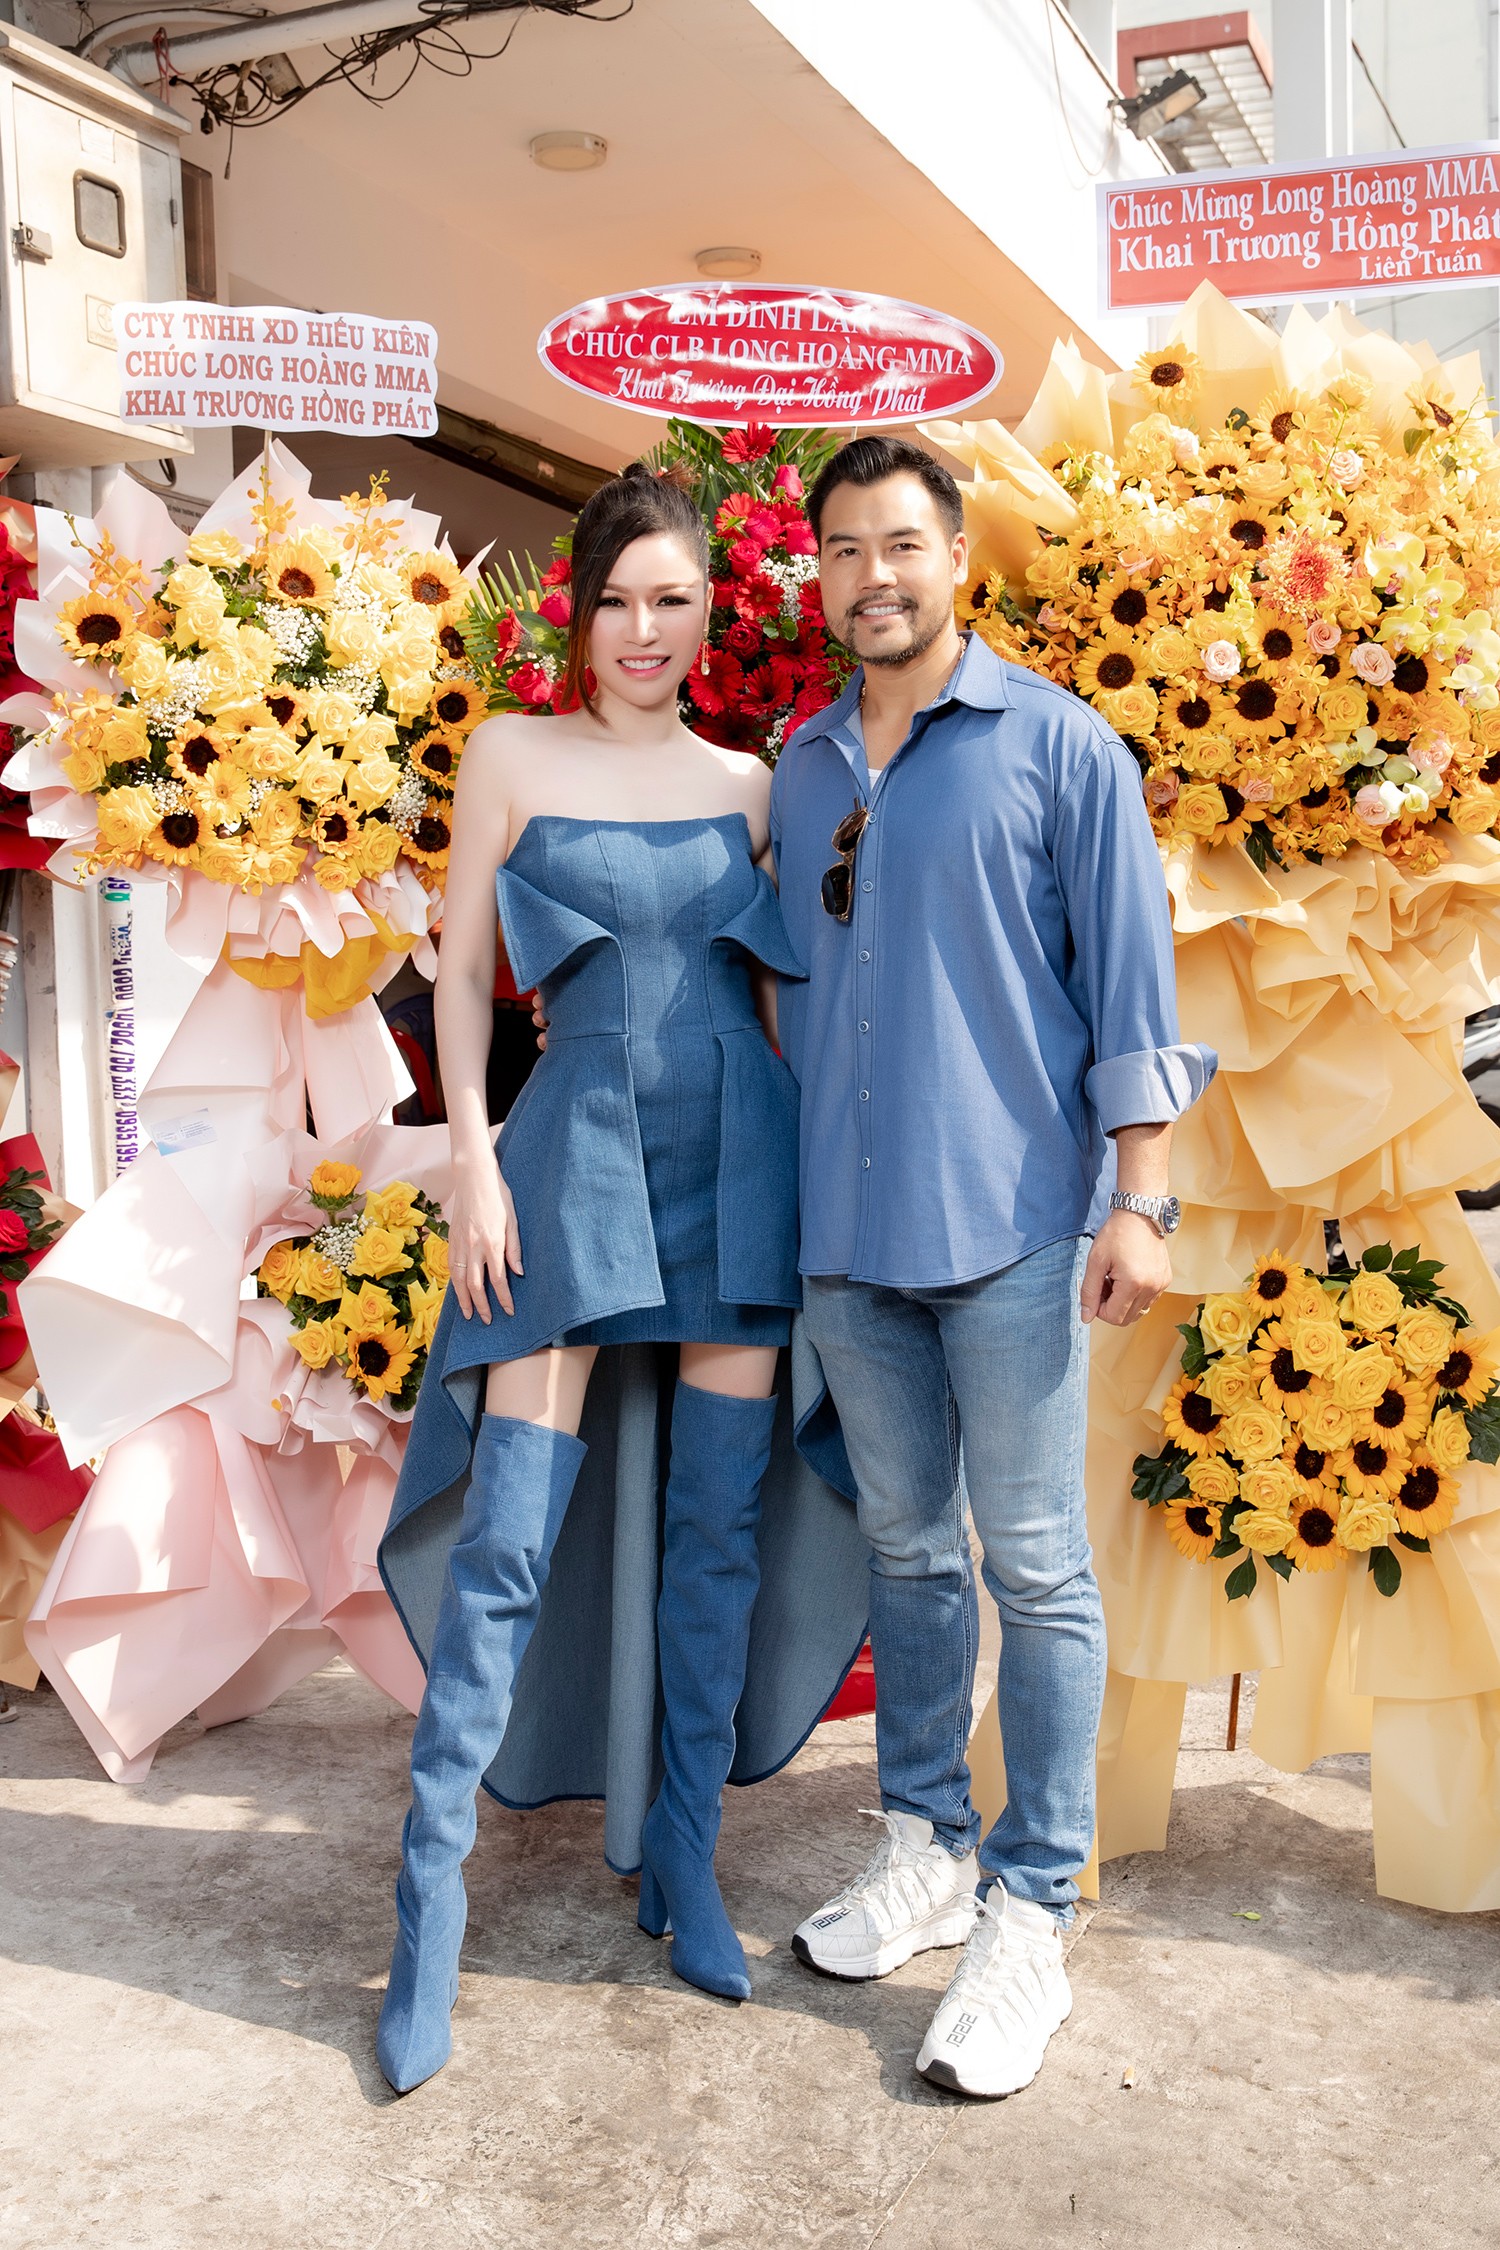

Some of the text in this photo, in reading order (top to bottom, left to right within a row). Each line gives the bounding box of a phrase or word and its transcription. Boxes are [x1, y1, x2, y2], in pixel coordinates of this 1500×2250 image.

[1109, 157, 1500, 231] Chúc Mừng Long Hoàng MMA
[1117, 204, 1500, 272] Khai Trương Hồng Phát
[1359, 246, 1483, 280] Liên Tuấn
[124, 312, 175, 339] CTY
[183, 313, 255, 343] TNHH
[262, 318, 299, 345] XD
[372, 324, 430, 358] KIÊN
[566, 325, 974, 376] CHÚC CLB LONG HOÀNG MMA
[125, 344, 432, 394] CHÚC LONG HOÀNG MMA
[608, 366, 666, 400] Khai
[752, 374, 797, 414] Đại
[802, 375, 864, 417] Hồng
[869, 380, 927, 417] Phát
[125, 388, 433, 430] KHAI TRƯƠNG HỒNG PHÁT
